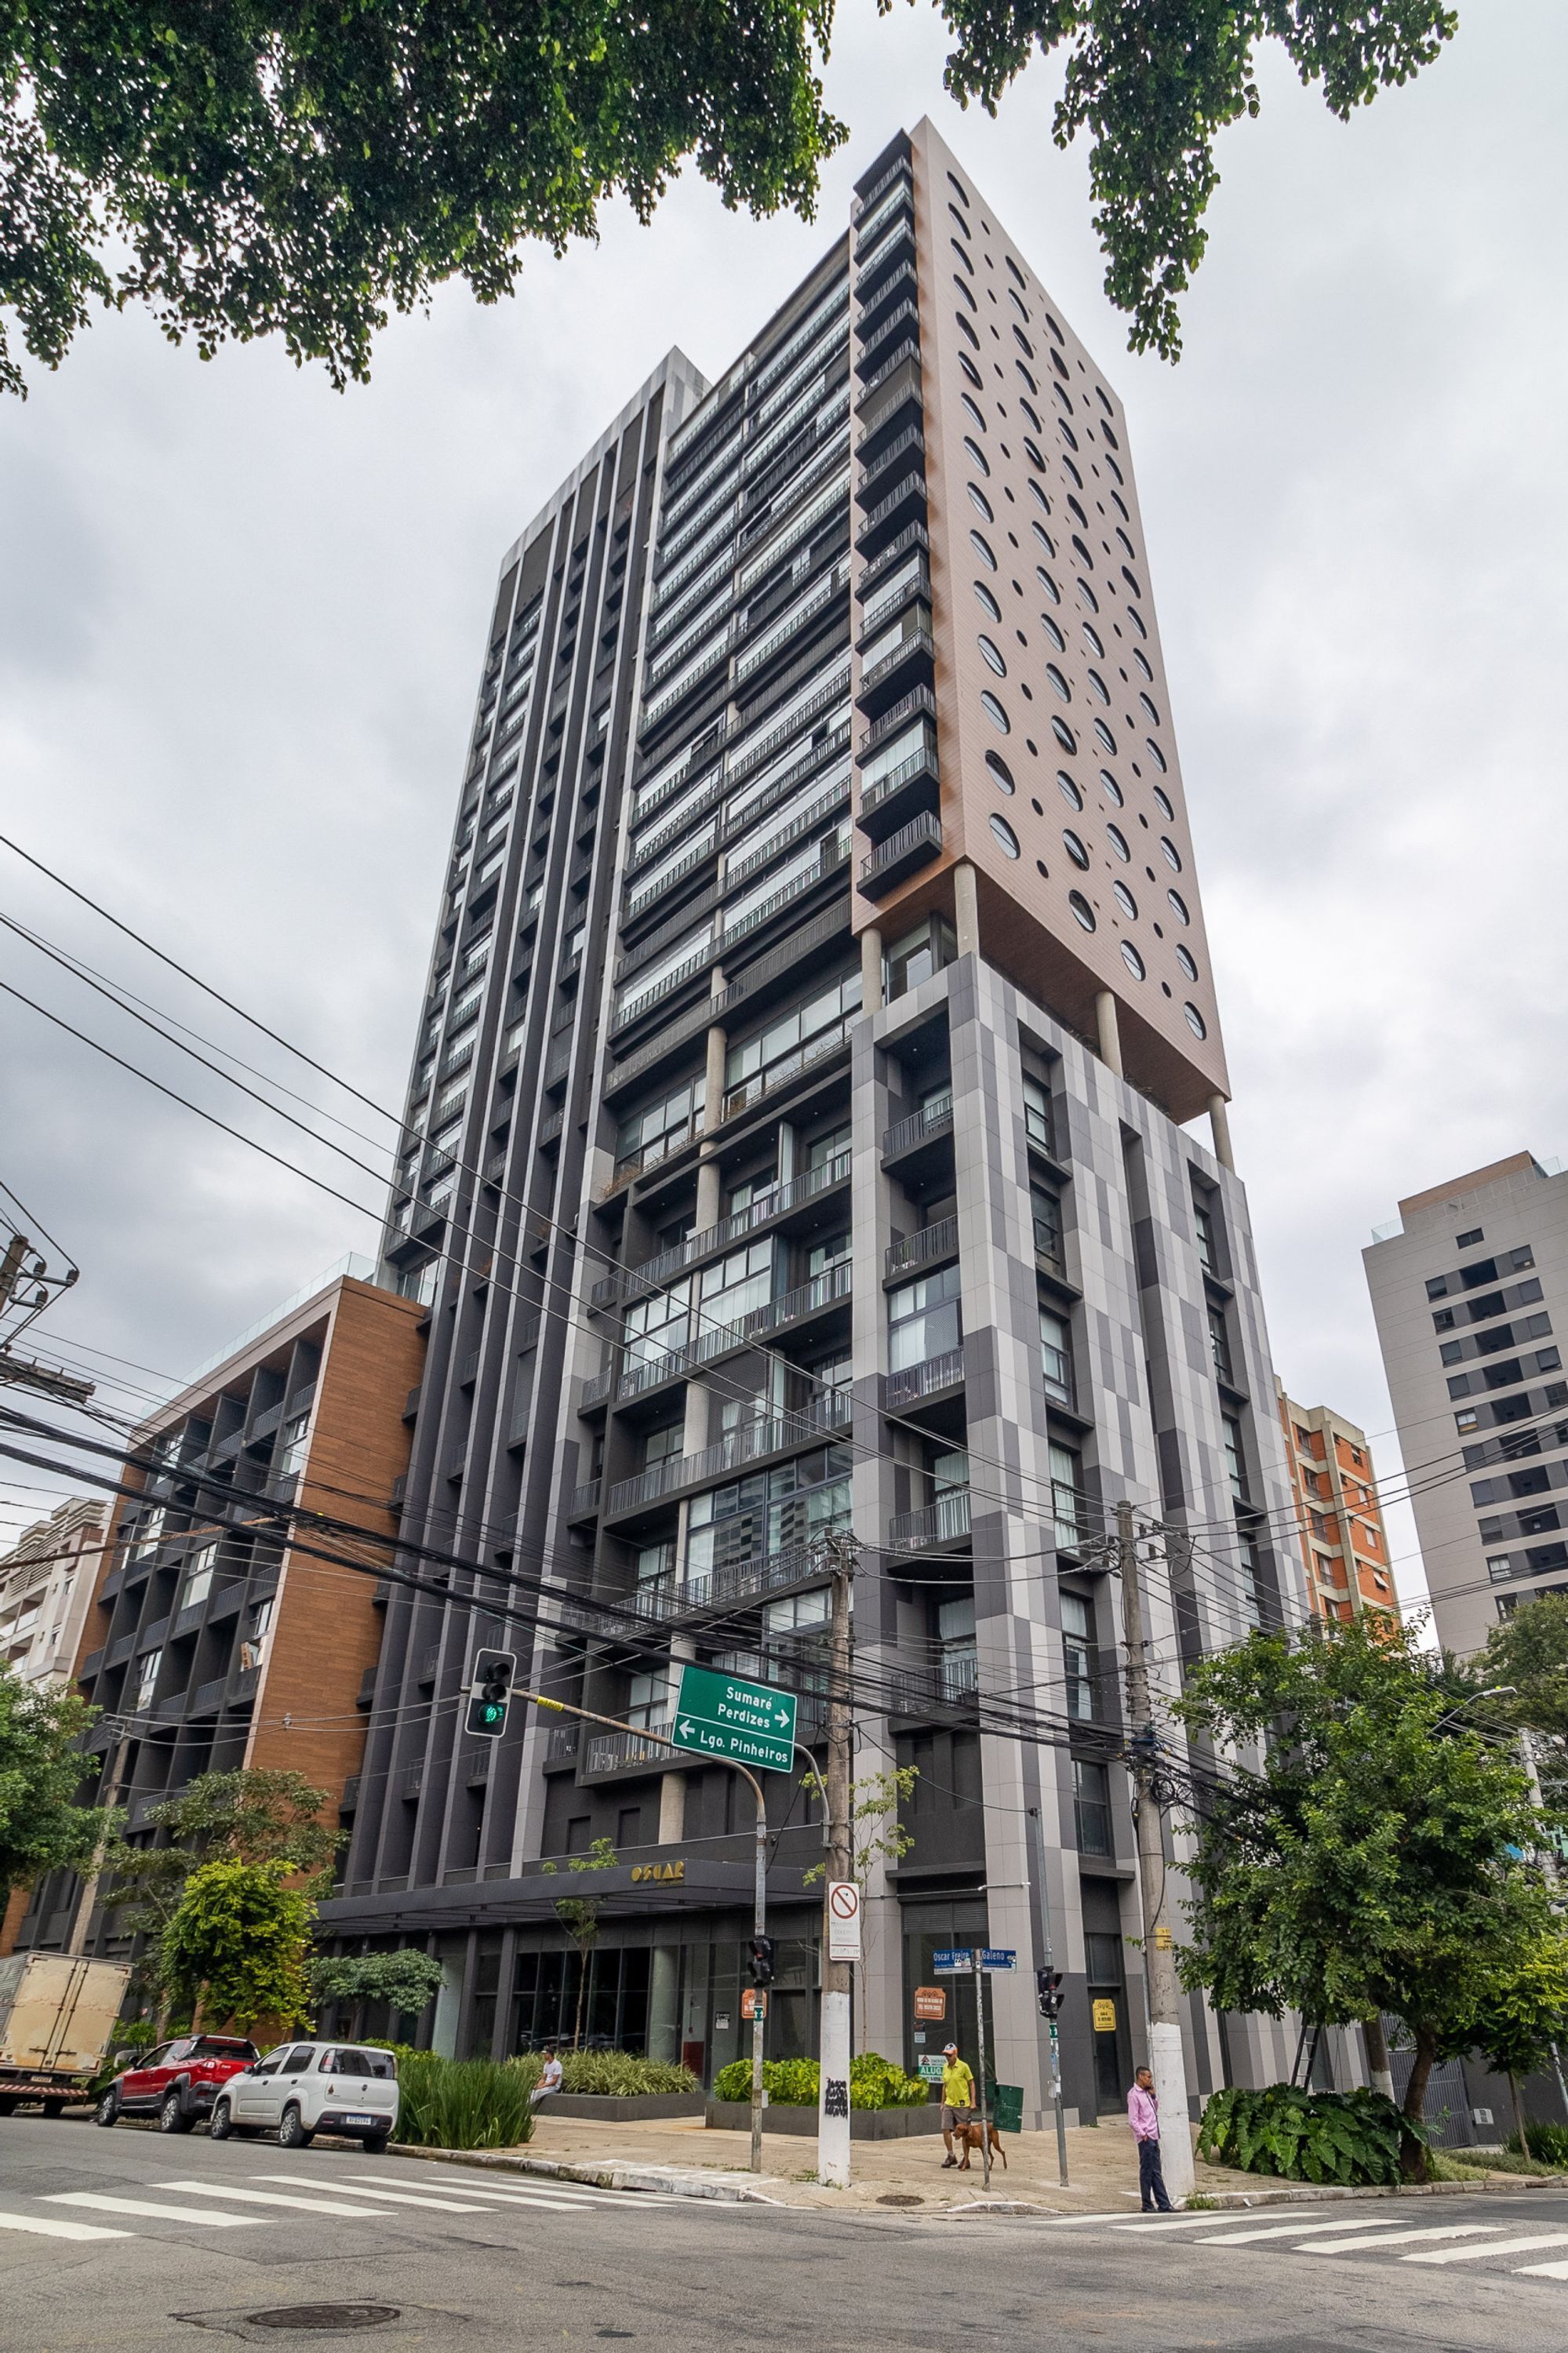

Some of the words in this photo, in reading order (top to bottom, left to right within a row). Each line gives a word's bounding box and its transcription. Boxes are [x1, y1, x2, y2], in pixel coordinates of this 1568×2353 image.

[726, 1686, 773, 1710] Sumaré
[718, 1703, 770, 1729] Perdizes
[700, 1730, 726, 1748] Lgo.
[730, 1737, 788, 1763] Pinheiros
[631, 1861, 684, 1882] OSCAR
[933, 1952, 950, 1962] Oscar
[981, 1951, 1005, 1961] Galeno
